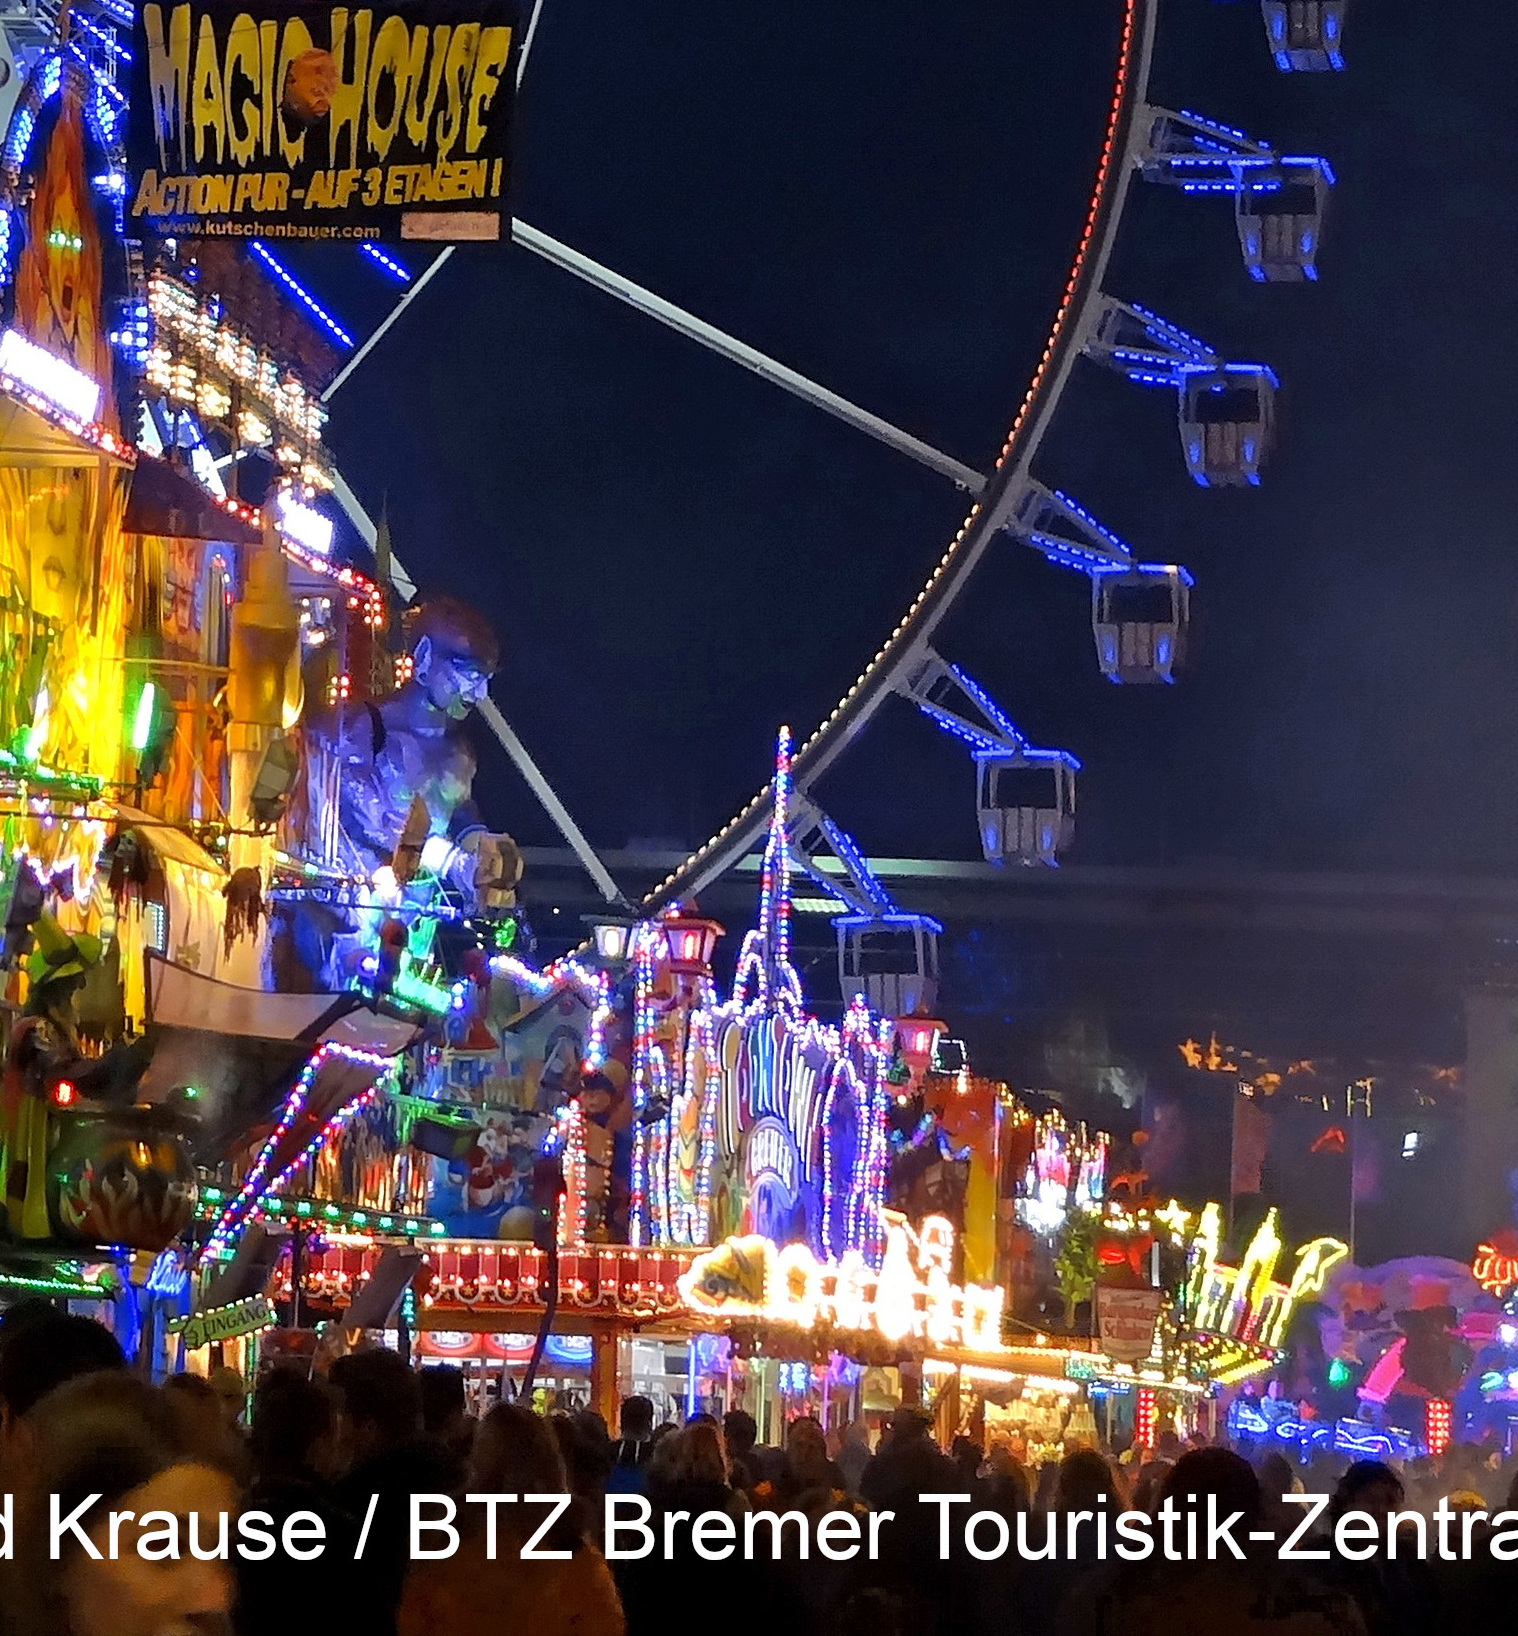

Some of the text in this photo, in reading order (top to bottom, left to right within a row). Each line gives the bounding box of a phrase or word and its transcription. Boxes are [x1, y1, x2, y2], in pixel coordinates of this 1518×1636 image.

[328, 7, 513, 170] HOUSE
[132, 168, 234, 216] ACTION
[233, 172, 290, 214] PUR
[303, 168, 363, 209] AUF
[361, 166, 384, 206] 3
[156, 218, 381, 240] www.kutschenbauer.com
